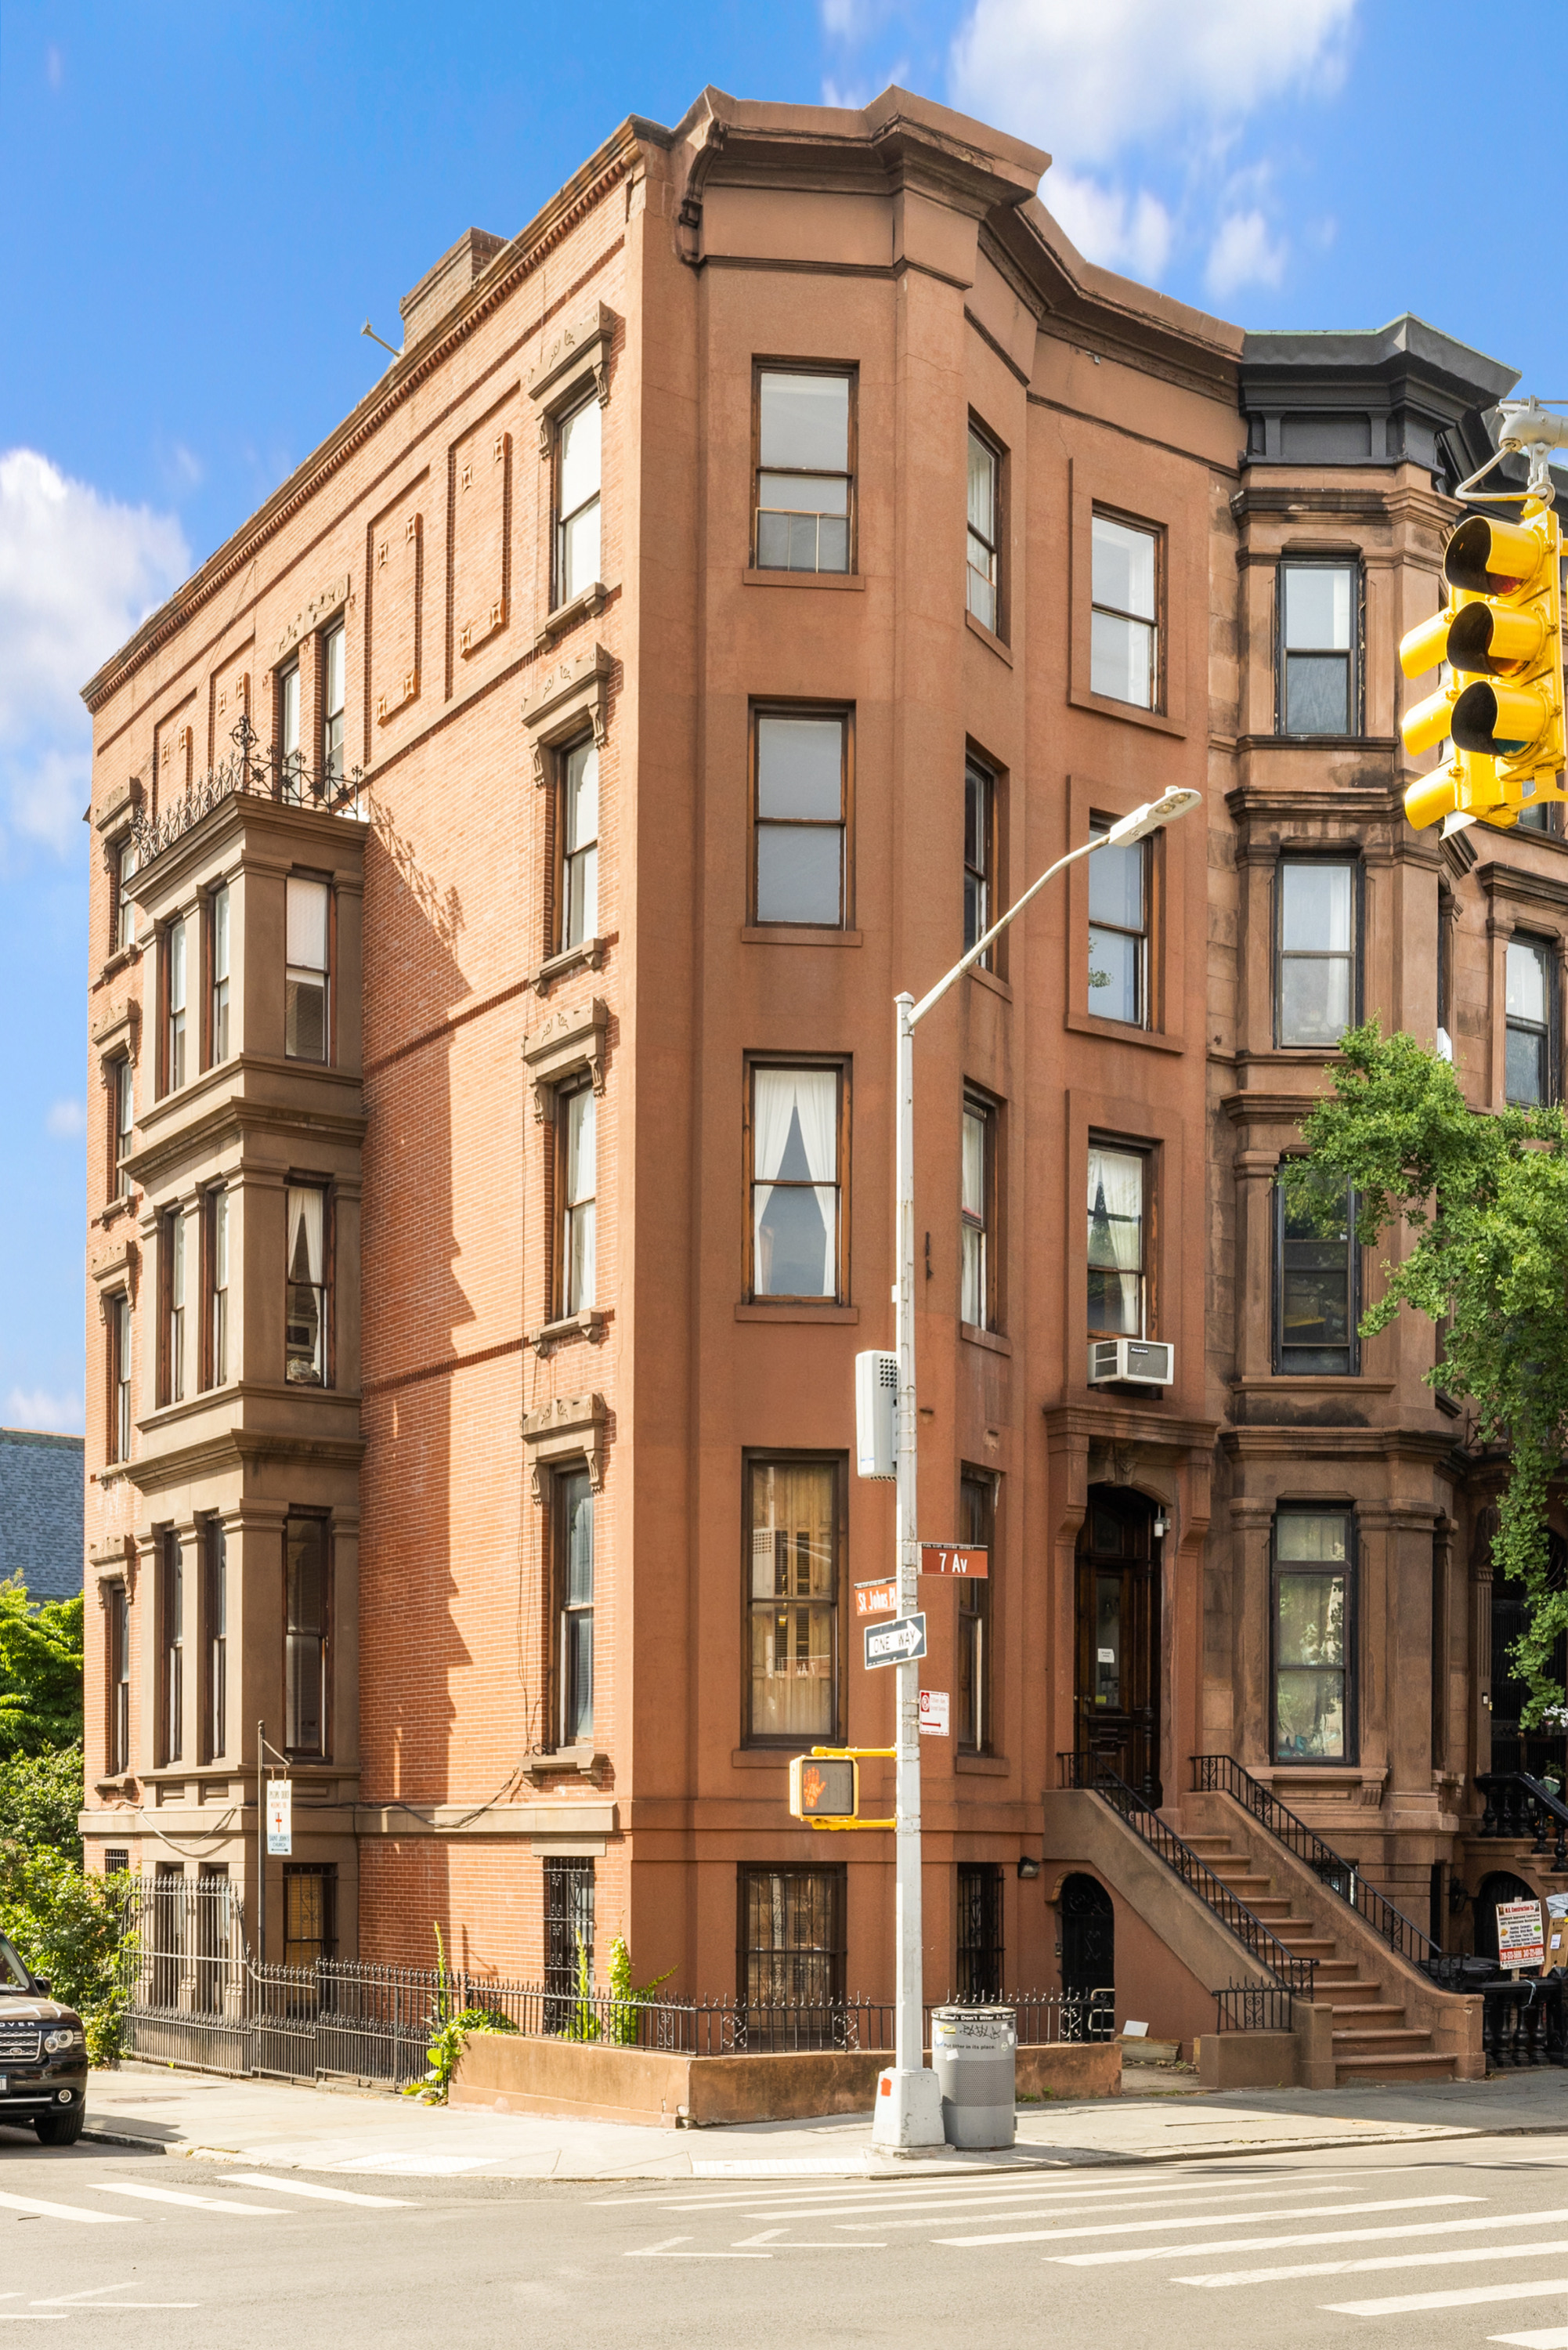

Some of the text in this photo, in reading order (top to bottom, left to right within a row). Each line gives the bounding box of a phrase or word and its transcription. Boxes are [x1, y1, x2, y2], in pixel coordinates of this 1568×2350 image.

[938, 1553, 968, 1574] 7 Av
[858, 1587, 896, 1612] St Johns Pl
[873, 1629, 916, 1654] ONE WAY
